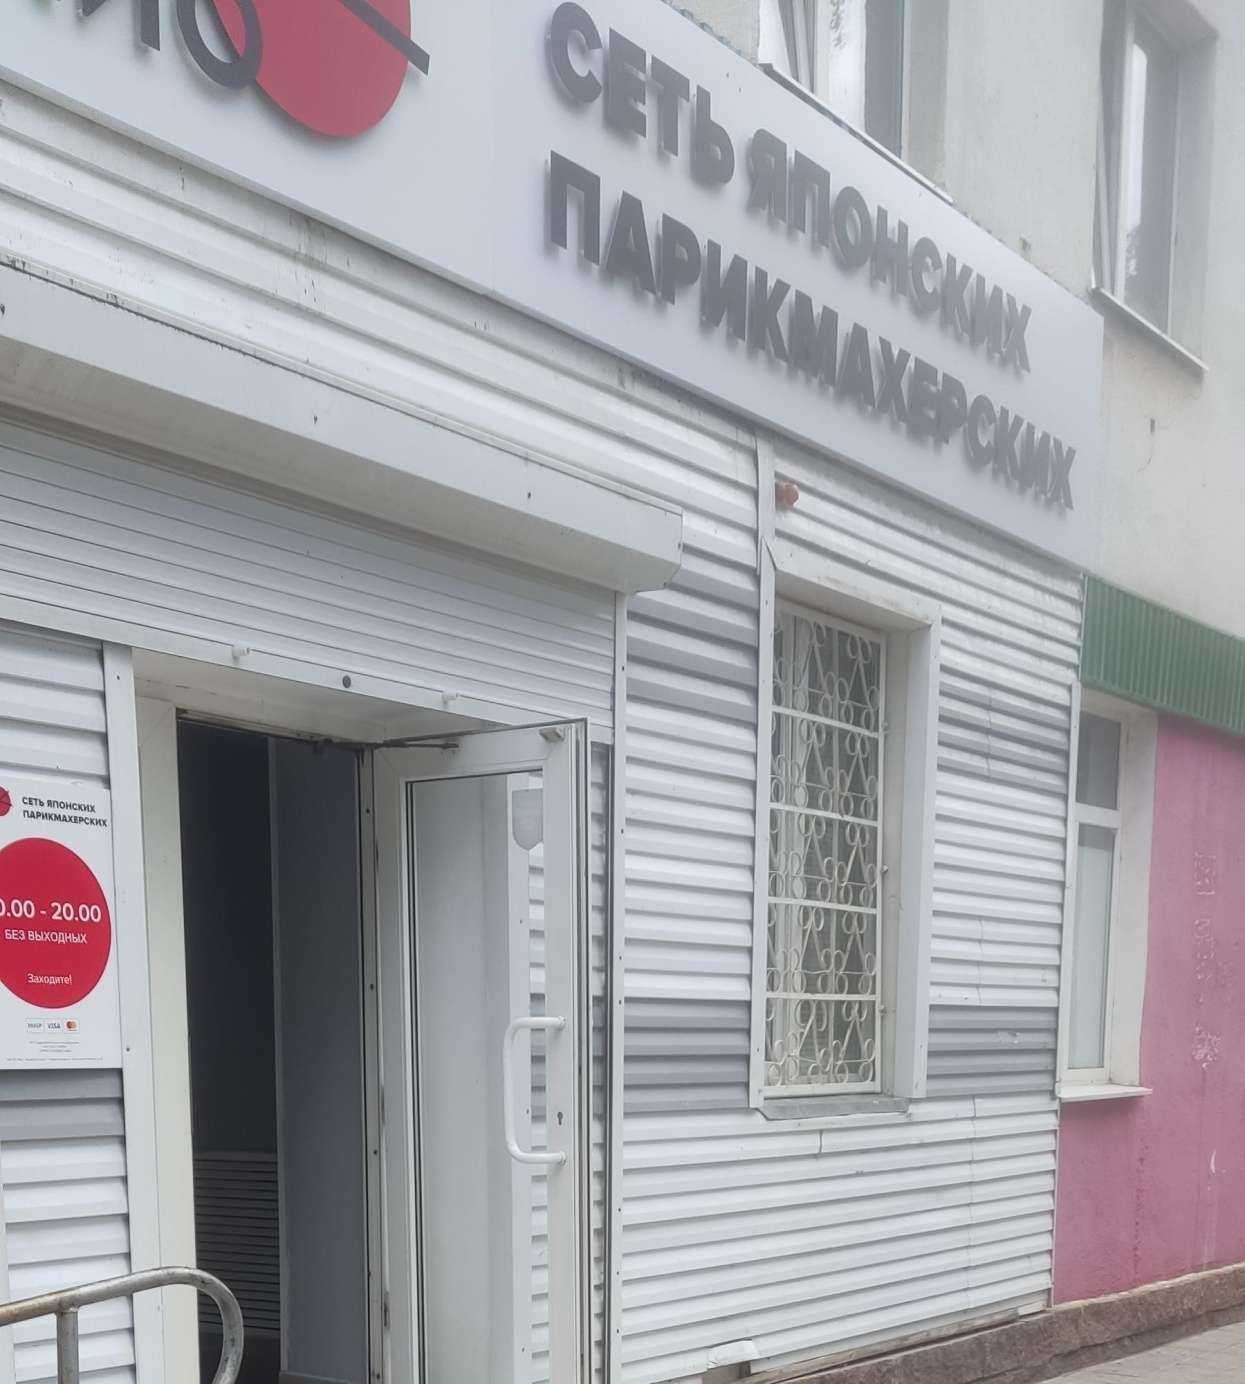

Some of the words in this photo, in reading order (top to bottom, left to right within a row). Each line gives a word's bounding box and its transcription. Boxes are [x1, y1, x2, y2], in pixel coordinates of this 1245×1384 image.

[546, 2, 735, 186] СЕТЬ
[749, 128, 1031, 373] ЯПОНСКИХ
[548, 150, 1077, 511] ПАРИКМАХЕРСКИХ
[22, 796, 45, 807] СЕТЬ
[46, 799, 97, 813] ЯПОНСКИХ
[23, 810, 108, 828] ПАРИКМАХЕРСКИХ
[50, 902, 101, 922] 20.00
[4, 928, 25, 940] БЕЗ
[27, 930, 88, 944] ВЫХОДНЫХ
[27, 973, 73, 985] Заходите!
